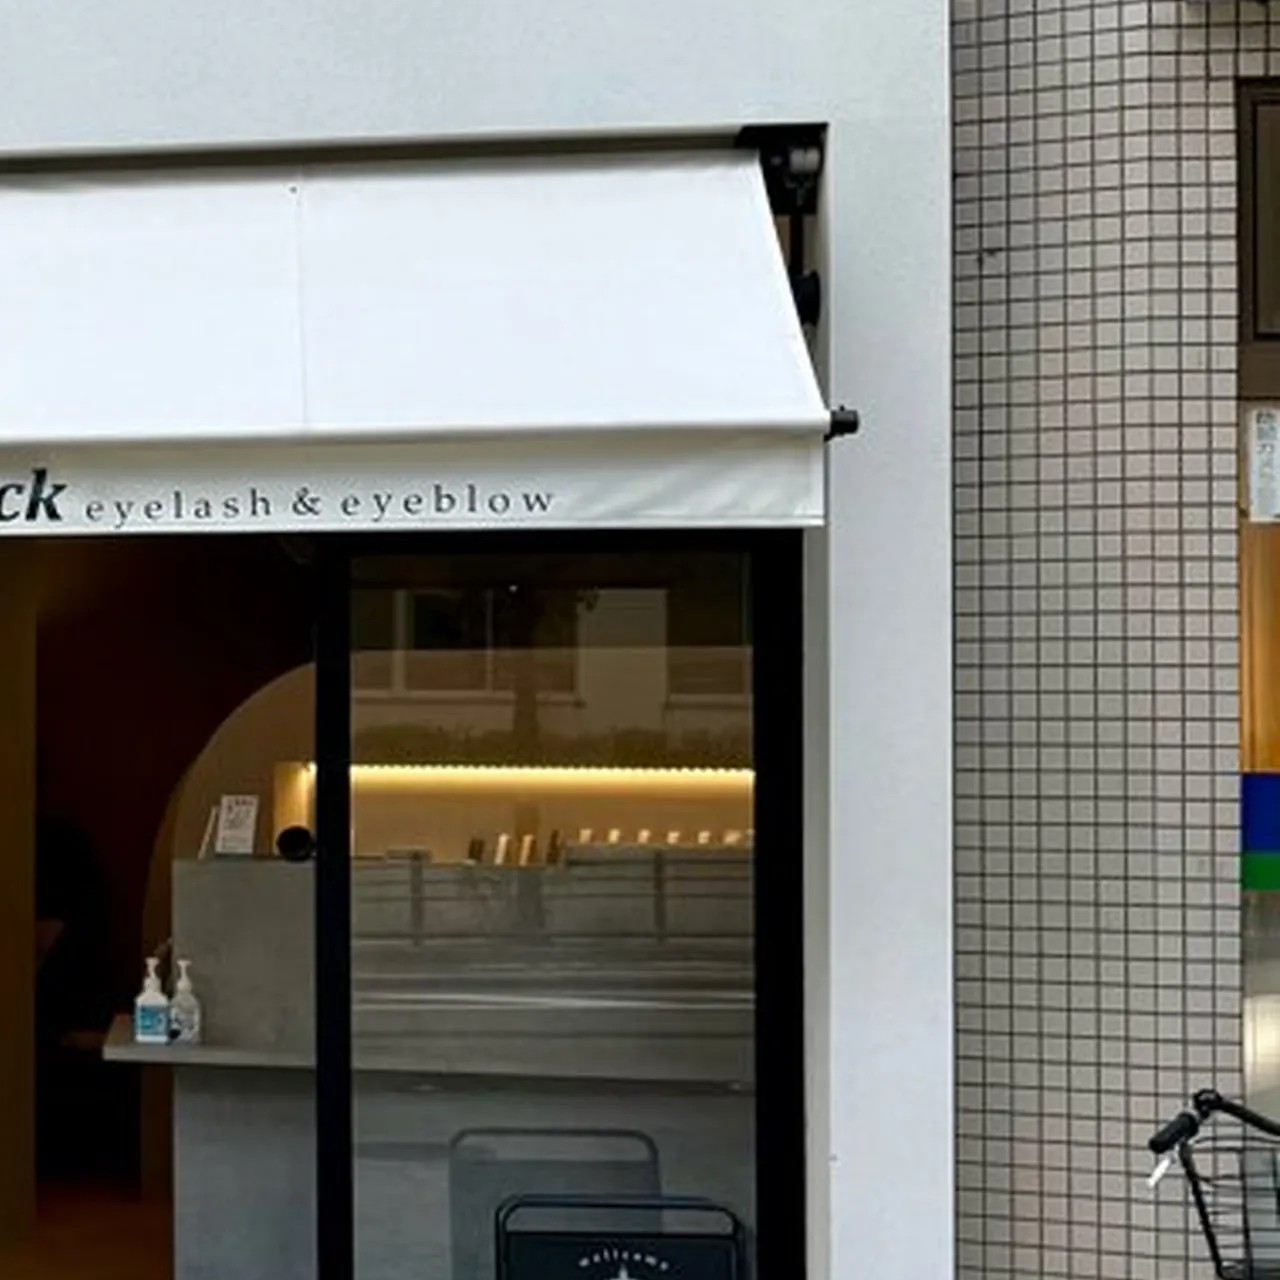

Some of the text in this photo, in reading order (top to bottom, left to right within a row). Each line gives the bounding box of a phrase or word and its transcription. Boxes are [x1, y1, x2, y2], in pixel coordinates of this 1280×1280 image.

[85, 487, 272, 528] eyelash
[292, 486, 321, 517] &
[341, 483, 554, 523] eyeblow
